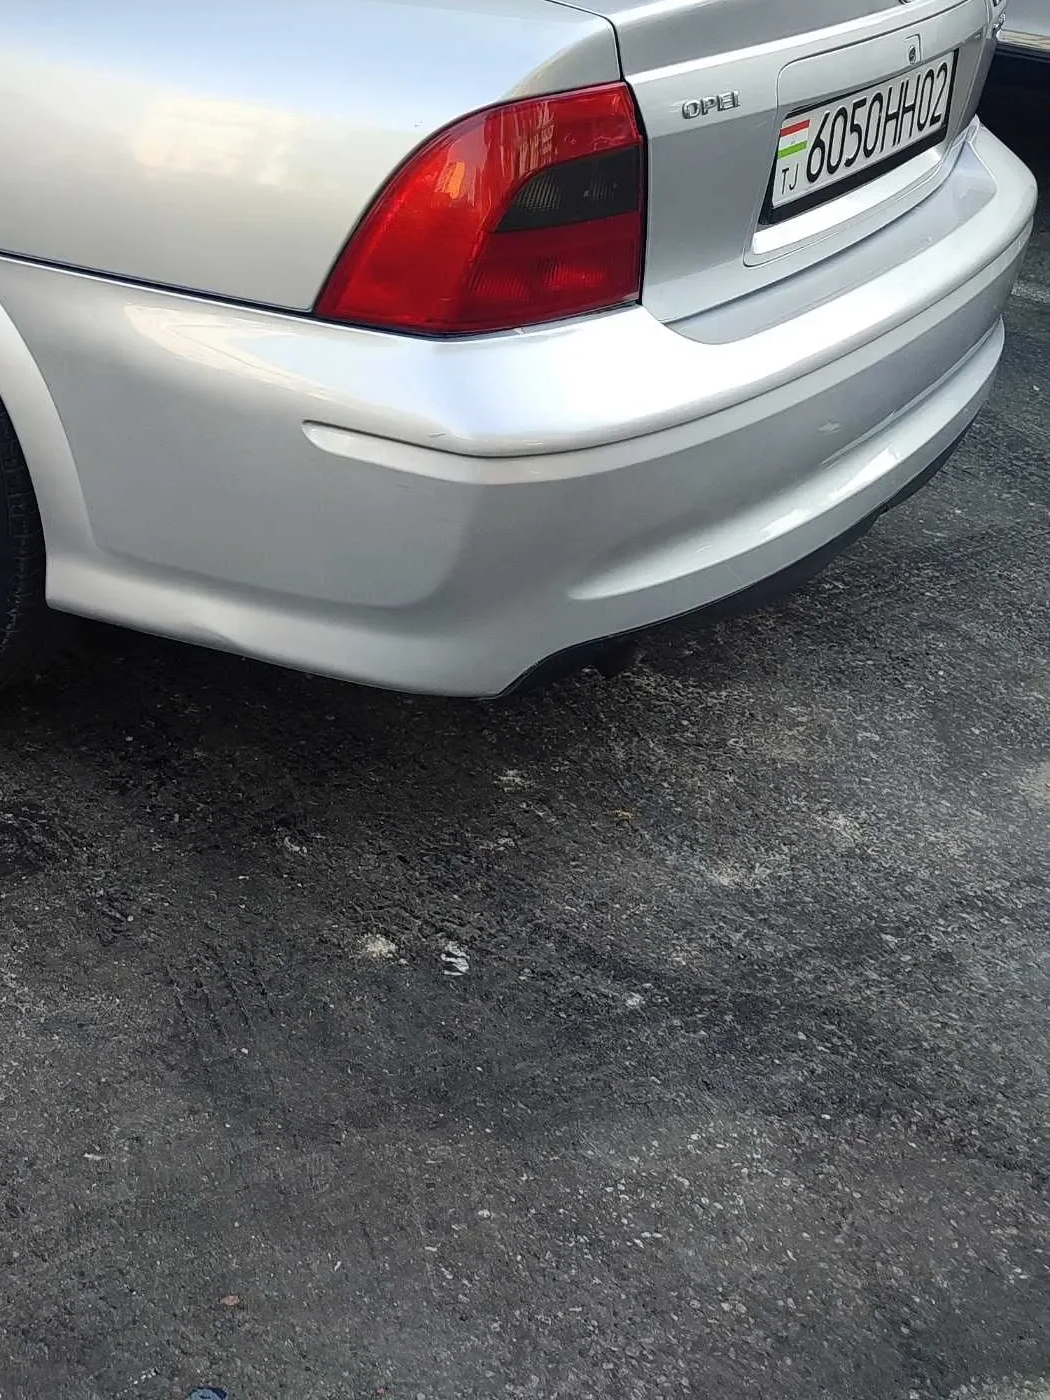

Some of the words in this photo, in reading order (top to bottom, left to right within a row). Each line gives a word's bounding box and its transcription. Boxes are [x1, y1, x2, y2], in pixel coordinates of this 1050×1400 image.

[682, 90, 741, 119] OPEL
[806, 61, 949, 183] 6050HH02
[781, 161, 800, 195] TJ
